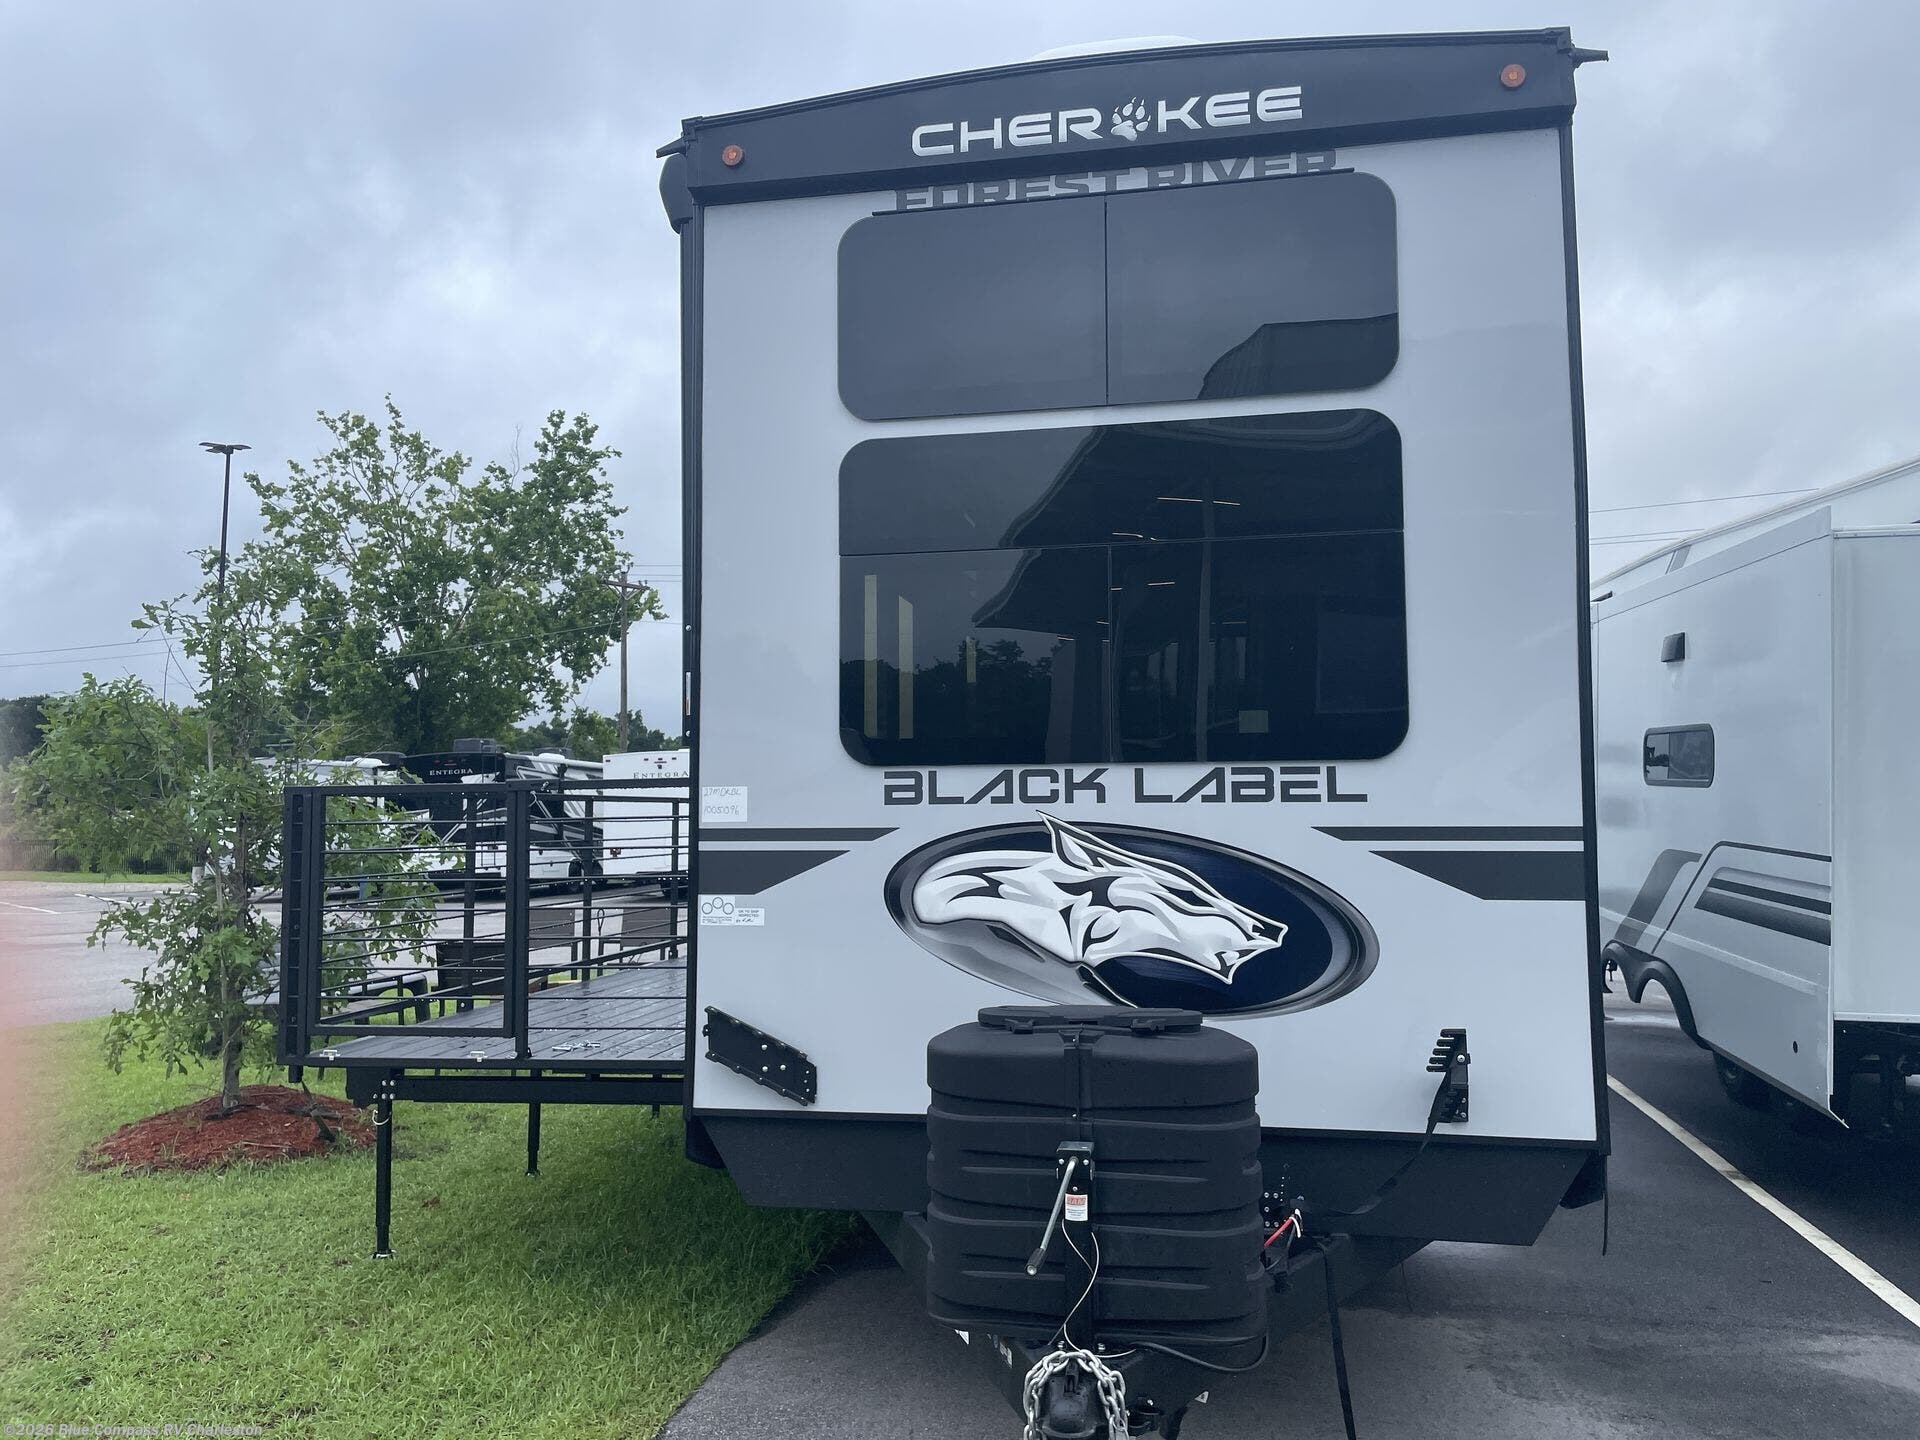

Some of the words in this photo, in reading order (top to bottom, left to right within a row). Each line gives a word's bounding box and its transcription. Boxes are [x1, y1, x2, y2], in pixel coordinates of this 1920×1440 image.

[896, 168, 1131, 210] FOREST
[1147, 150, 1336, 189] RIVER
[429, 768, 473, 776] ENTEGRA
[633, 771, 689, 779] ENTEGRA
[884, 768, 1109, 805] BLACK
[1134, 766, 1368, 803] LABEL
